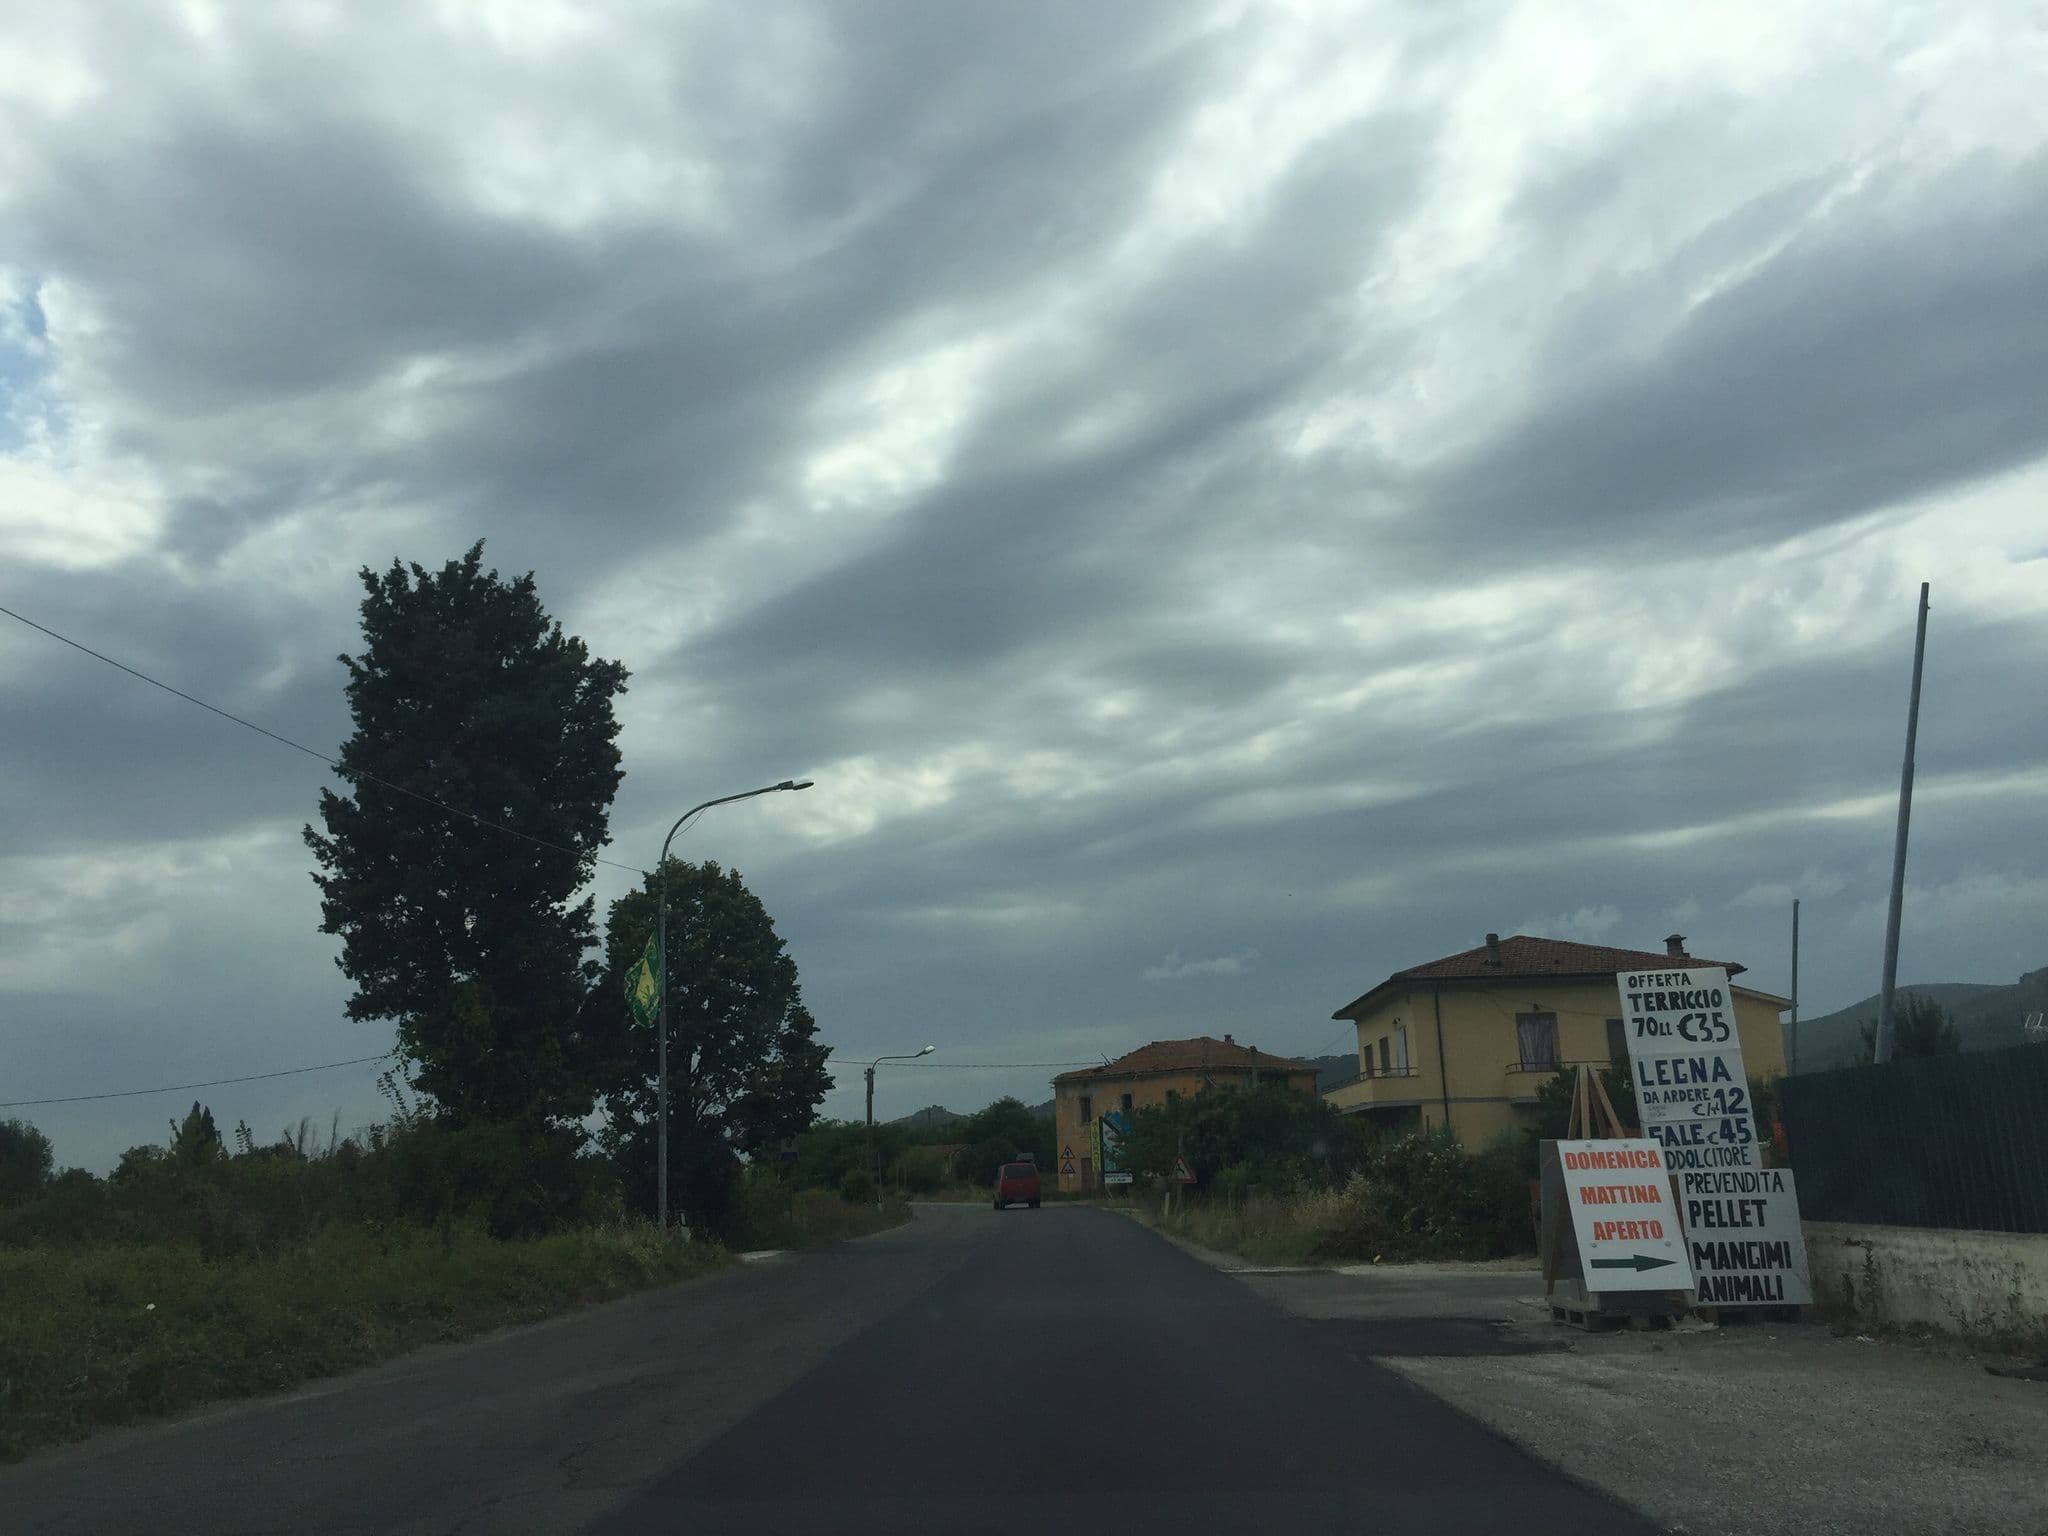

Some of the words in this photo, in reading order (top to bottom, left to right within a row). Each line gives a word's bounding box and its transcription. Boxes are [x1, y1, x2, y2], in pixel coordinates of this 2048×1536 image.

[1628, 972, 1691, 988] OFFERTA
[1627, 989, 1722, 1012] TERRICCIO
[1638, 1056, 1732, 1086] LEGNA
[1643, 1092, 1660, 1104] DA
[1664, 1088, 1710, 1103] ARDERE
[1713, 1087, 1748, 1115] 12
[1648, 1123, 1704, 1147] SALE
[1565, 1150, 1661, 1170] DOMENICA
[1665, 1146, 1751, 1170] DDOLCITORE
[1685, 1171, 1785, 1194] PREVENDITA
[1579, 1185, 1662, 1205] MATTINA
[1688, 1199, 1767, 1228] PELLET
[1593, 1220, 1664, 1241] APERTO
[1692, 1241, 1792, 1270] MANGIMI
[1698, 1275, 1785, 1302] ANIMALI
